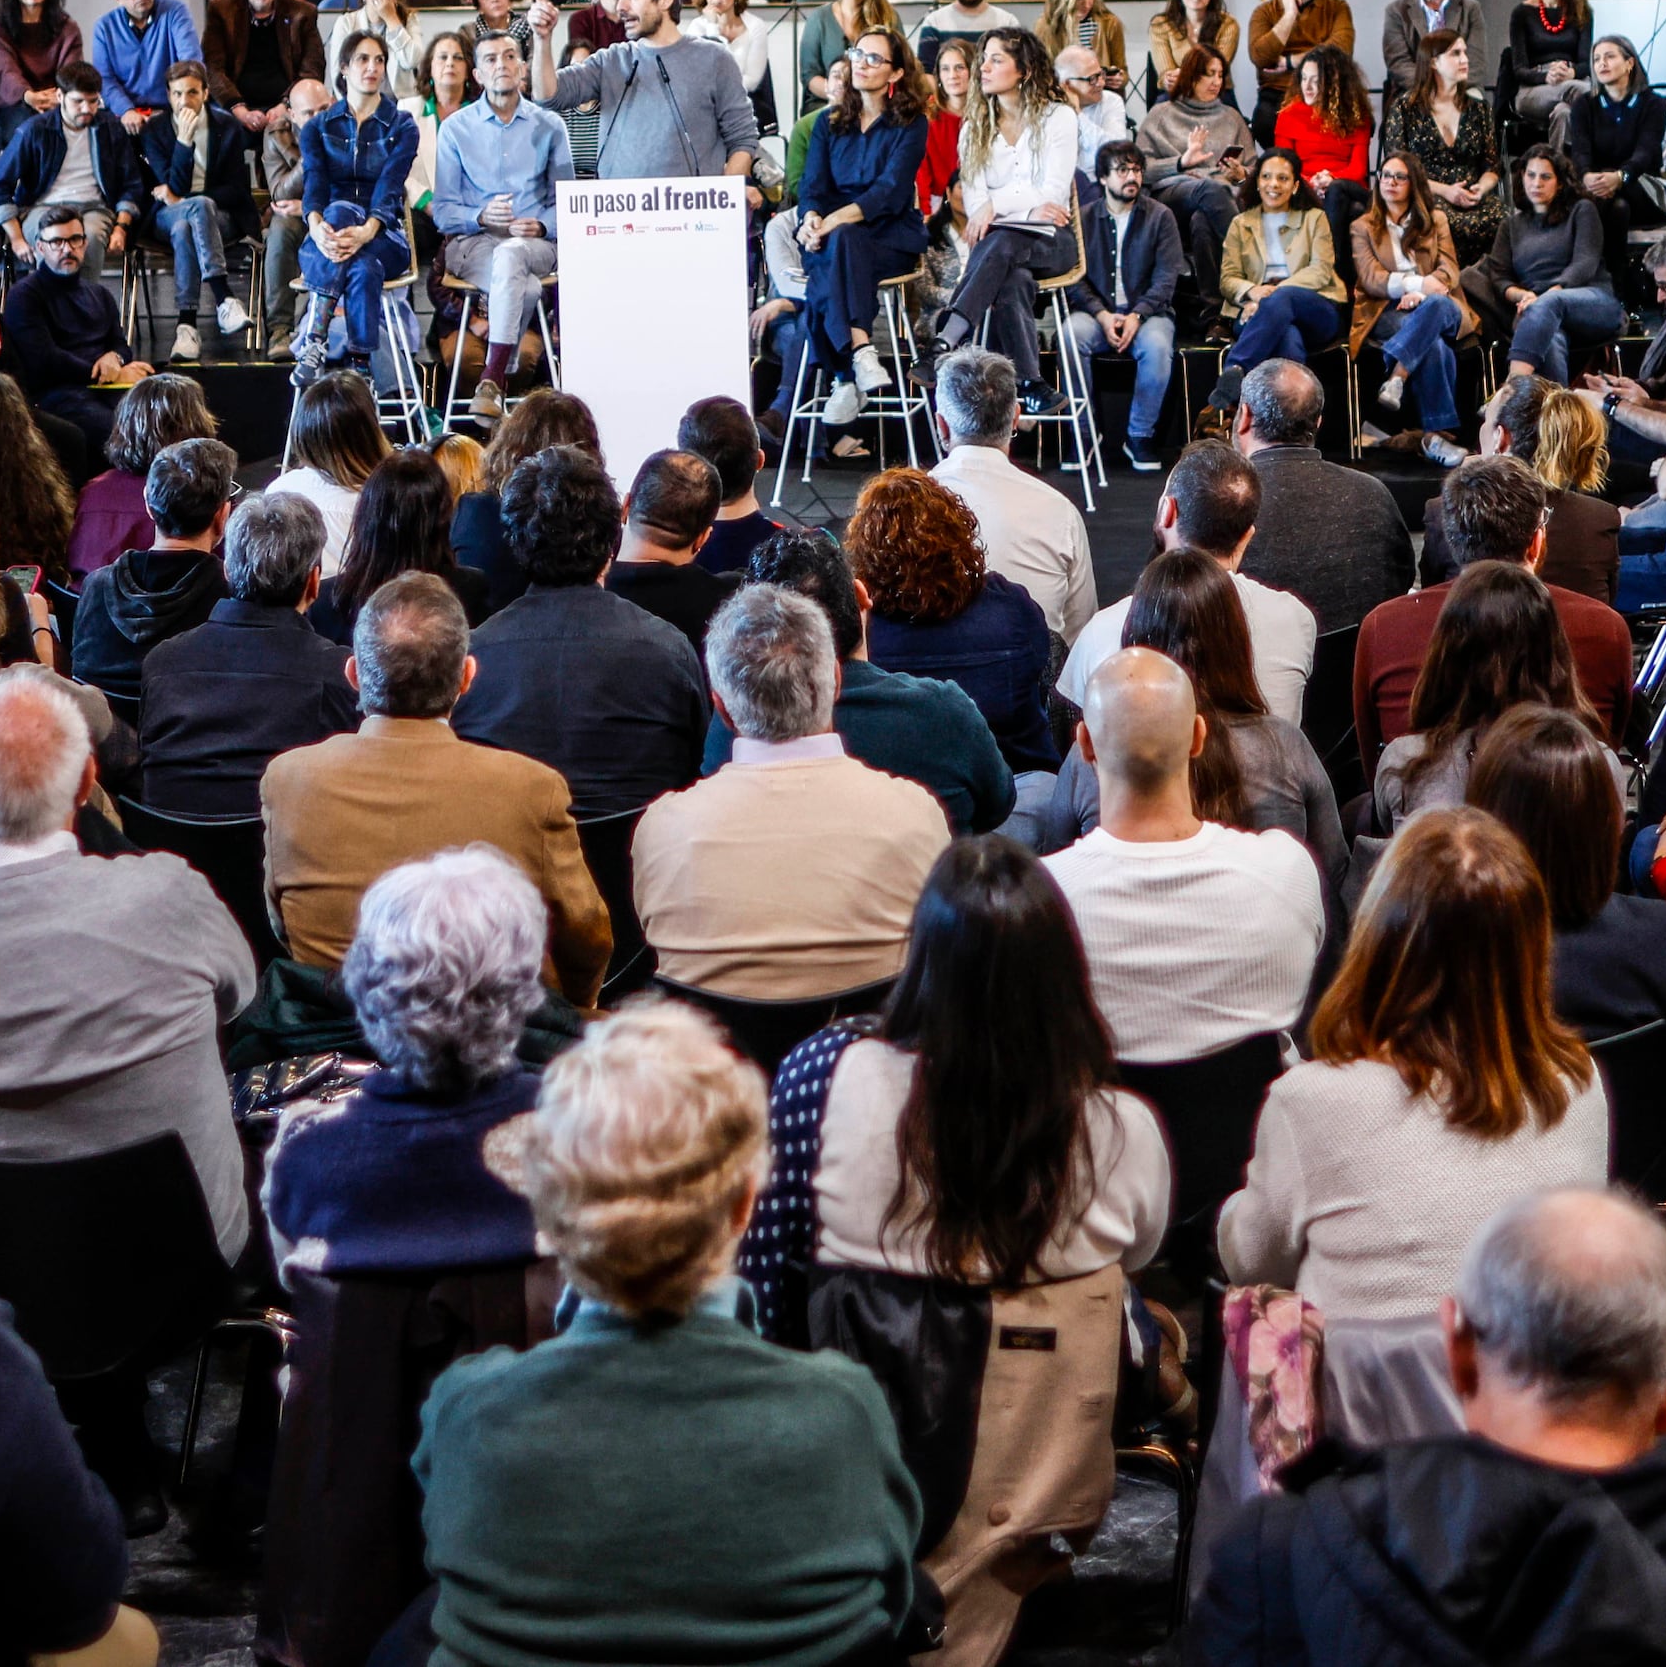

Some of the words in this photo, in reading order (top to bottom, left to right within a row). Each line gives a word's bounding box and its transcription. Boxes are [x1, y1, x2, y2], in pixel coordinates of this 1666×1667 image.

[570, 195, 588, 213] un
[594, 194, 636, 218] paso
[642, 187, 659, 211] al
[665, 186, 736, 210] frente.
